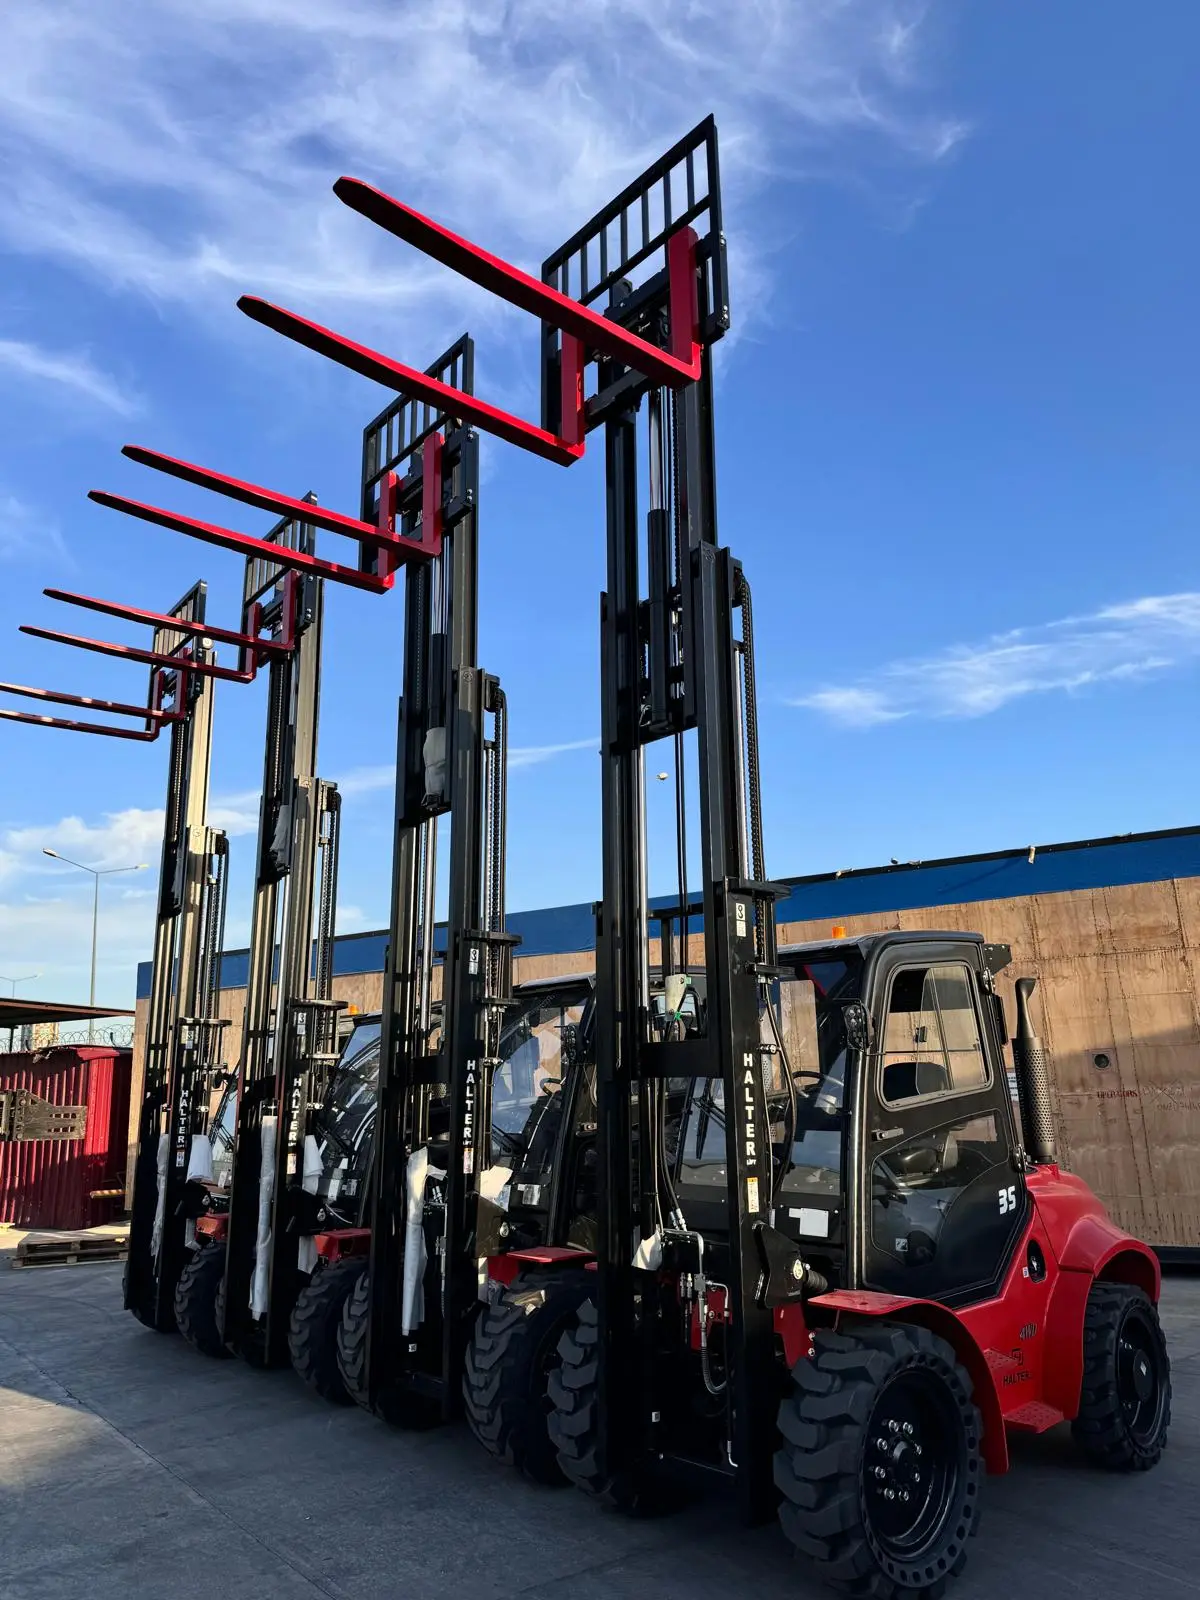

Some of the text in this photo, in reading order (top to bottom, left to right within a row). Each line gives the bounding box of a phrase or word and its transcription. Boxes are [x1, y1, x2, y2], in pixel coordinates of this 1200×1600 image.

[177, 1090, 188, 1143] HALTER
[288, 1078, 302, 1141] HALTER
[463, 1060, 476, 1138] HALTER
[743, 1053, 756, 1155] HALTER
[998, 1185, 1017, 1215] 35
